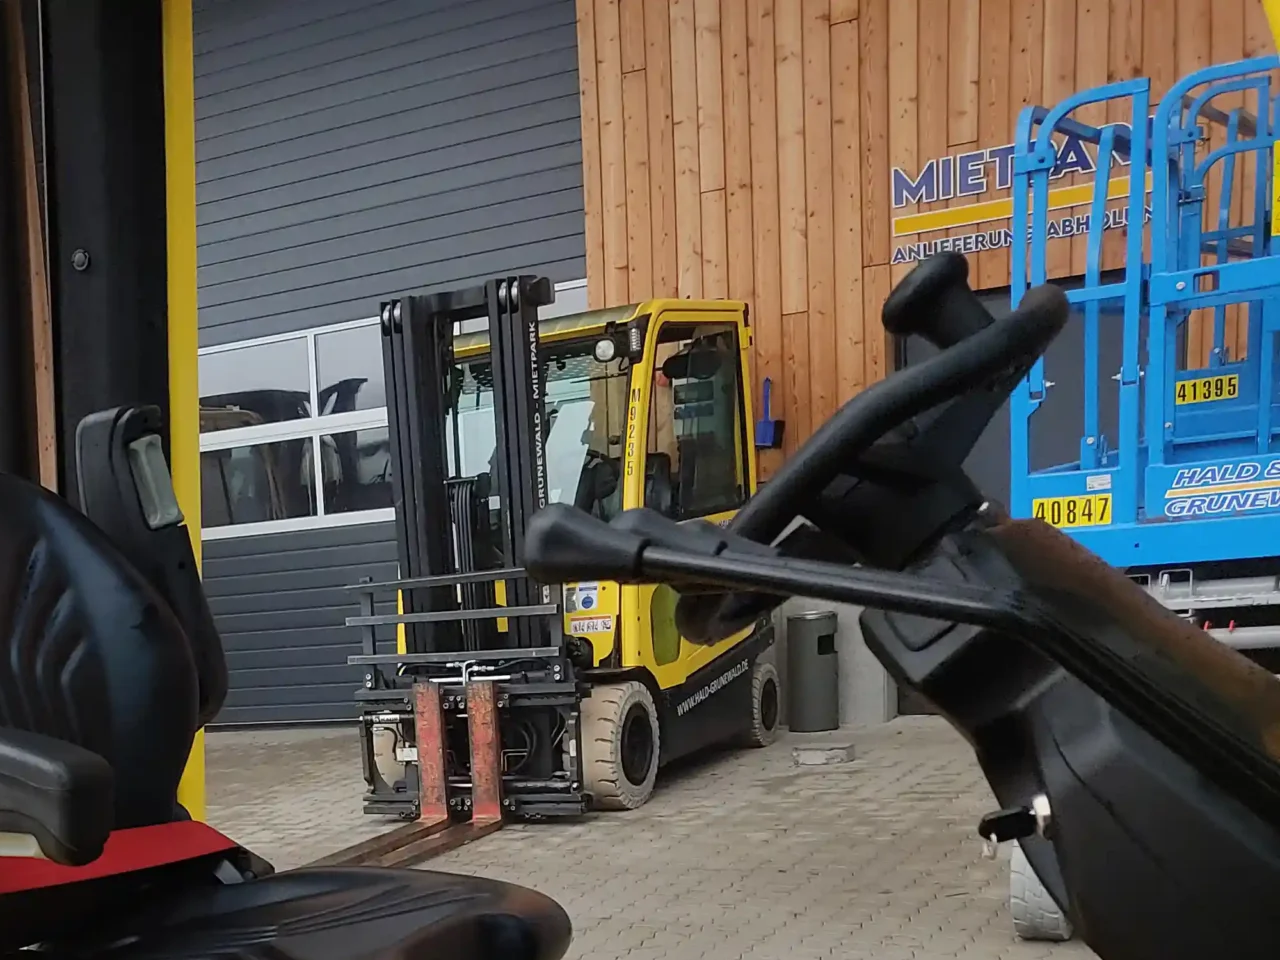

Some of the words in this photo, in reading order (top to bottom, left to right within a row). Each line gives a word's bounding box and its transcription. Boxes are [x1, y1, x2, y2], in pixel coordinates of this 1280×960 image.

[528, 321, 539, 399] MIETPARK
[1177, 376, 1237, 402] 41395
[533, 412, 546, 509] GRUNEWALD
[1172, 463, 1260, 488] HALD
[1035, 497, 1109, 525] 40847
[676, 658, 749, 716] WWW.HALD-GRUNEWALD.DE
